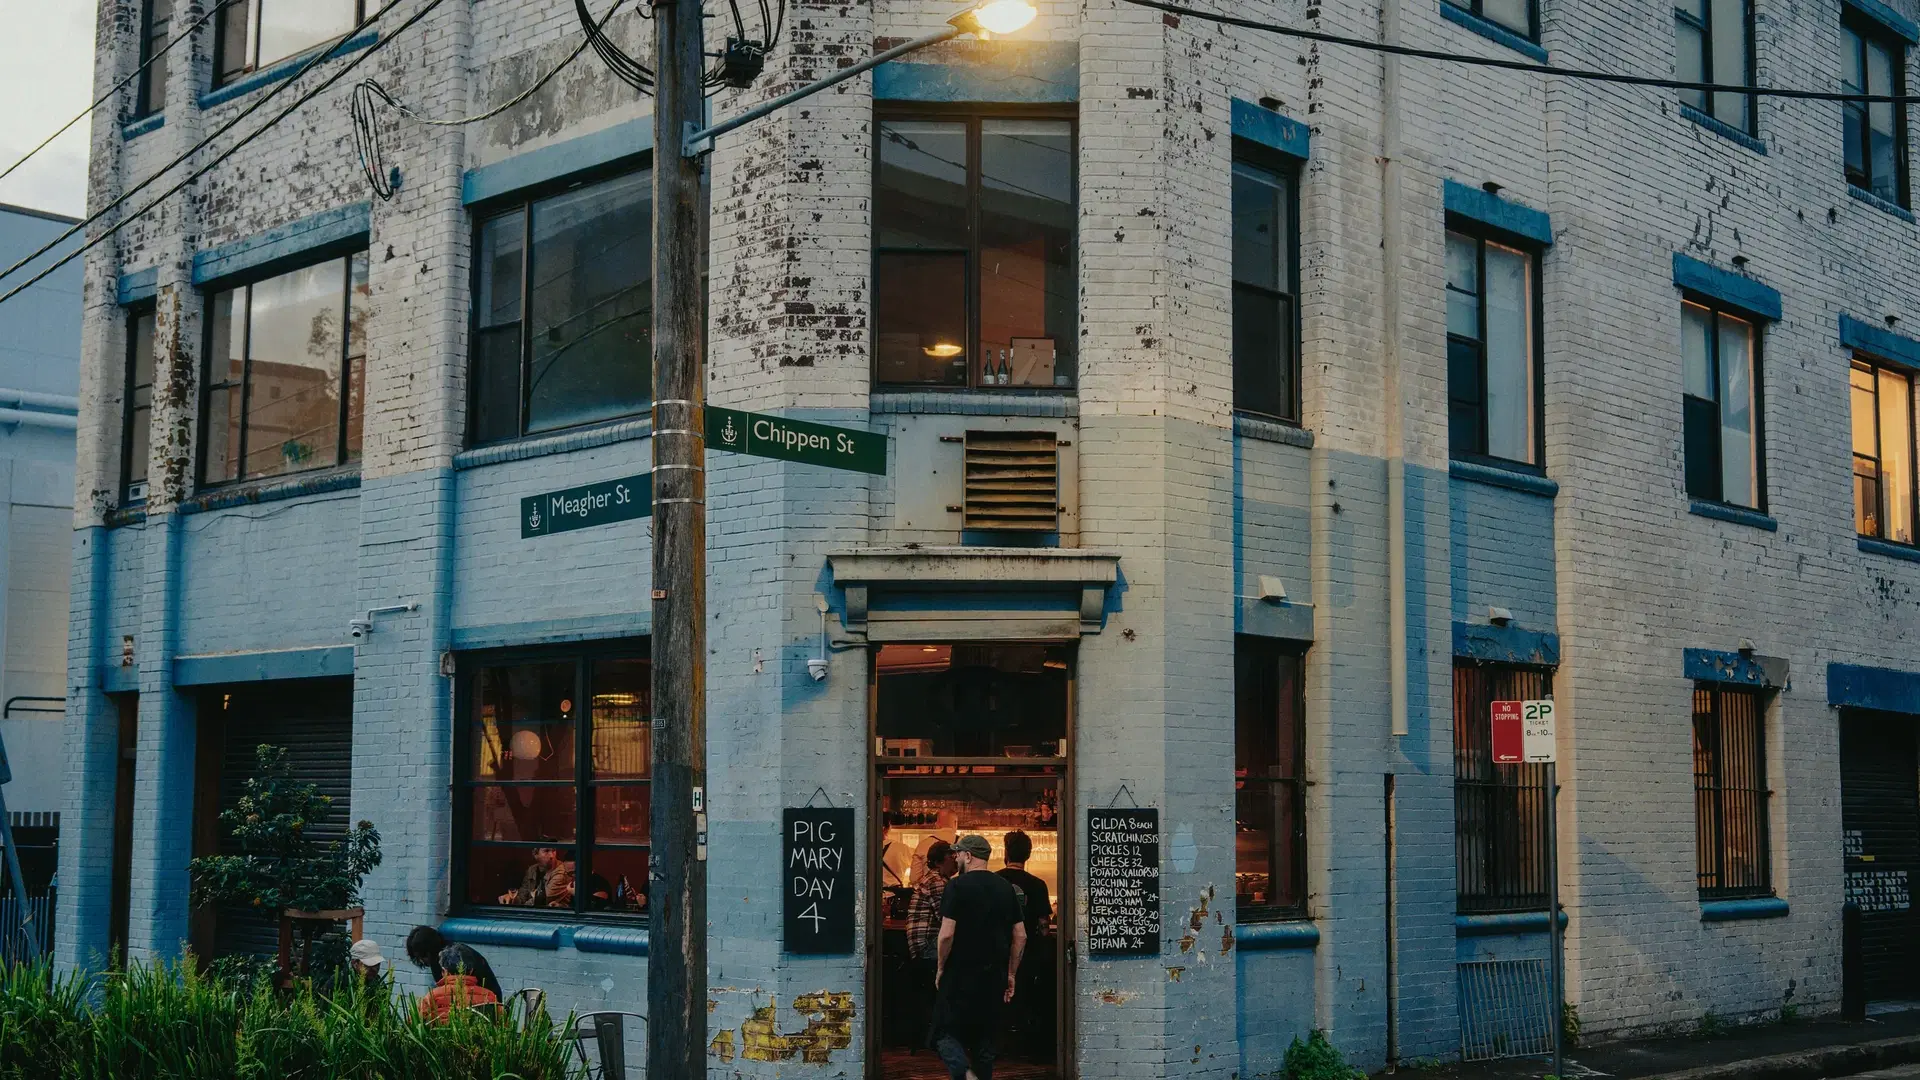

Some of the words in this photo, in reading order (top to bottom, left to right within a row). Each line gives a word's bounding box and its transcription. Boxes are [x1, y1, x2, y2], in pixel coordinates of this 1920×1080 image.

[753, 420, 830, 451] Chippen
[836, 433, 855, 454] St
[551, 490, 612, 517] Meagher
[616, 484, 631, 504] St
[1525, 704, 1552, 719] 2P
[694, 791, 701, 806] H
[1091, 817, 1127, 830] GILDA
[794, 820, 836, 843] PIG
[1090, 844, 1130, 856] PICKLES
[1132, 845, 1142, 857] 12
[790, 847, 843, 872] MARY
[1090, 856, 1130, 868] CHEESE
[1132, 858, 1144, 868] 32
[1090, 867, 1120, 877] POTATO
[793, 876, 835, 900] DAY
[1090, 877, 1129, 888] ZUCCHINI
[1130, 879, 1143, 888] 24
[1090, 887, 1113, 897] PARM
[1114, 888, 1142, 897] DONUT
[1093, 896, 1123, 905] EMILIOS
[1125, 897, 1143, 906] HAM
[1147, 893, 1159, 902] 24
[797, 901, 827, 934] 4
[1120, 906, 1147, 916] BLOOD
[1149, 910, 1159, 920] 20
[1090, 925, 1118, 937] LAMB
[1119, 926, 1146, 936] STICKS
[1147, 924, 1160, 933] 20
[1090, 937, 1128, 950] BIFANA
[1130, 937, 1144, 949] 24
